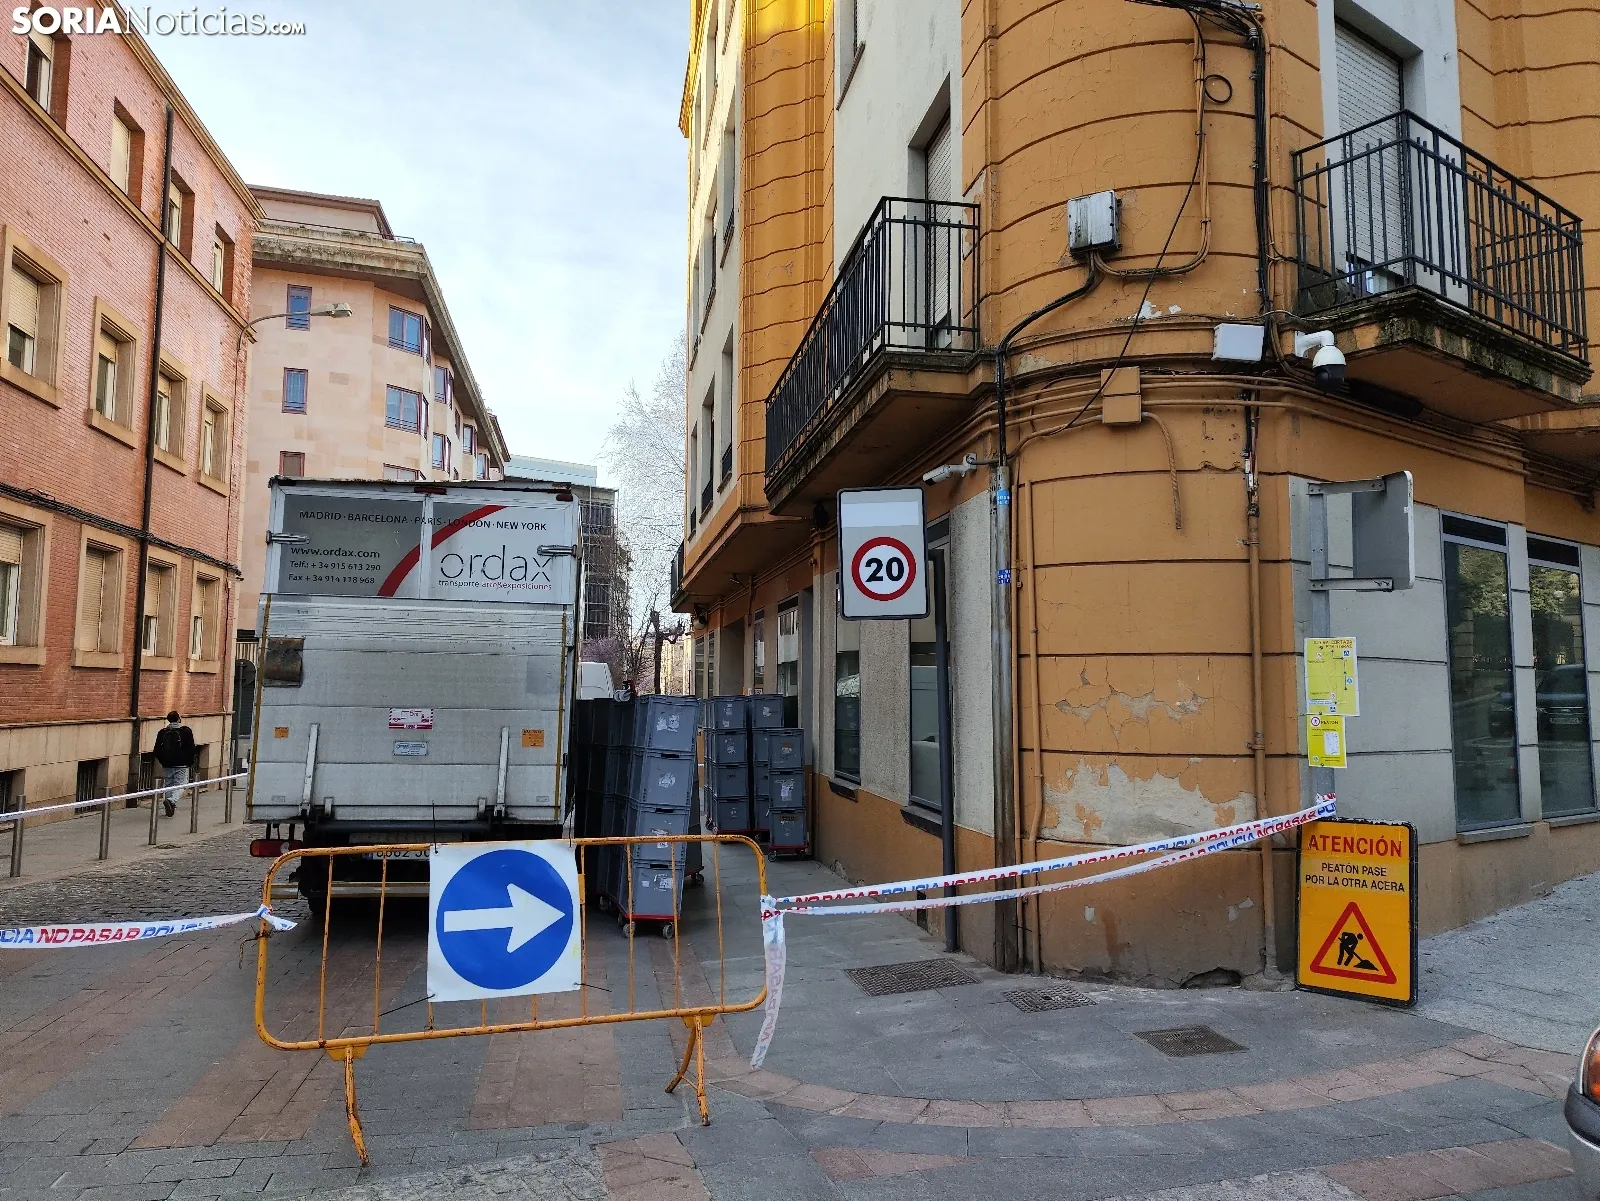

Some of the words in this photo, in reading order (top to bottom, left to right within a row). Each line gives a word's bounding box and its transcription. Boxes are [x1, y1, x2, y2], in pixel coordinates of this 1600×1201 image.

[299, 511, 342, 520] MADRID
[348, 513, 408, 524] BARCELONA
[496, 521, 518, 530] NEW
[521, 522, 547, 531] YORK
[290, 547, 380, 558] www.ordax.com
[441, 545, 551, 583] ordax
[864, 556, 905, 583] 20
[1308, 834, 1403, 858] ATENCIÓN
[1321, 862, 1359, 875] PEATÓN
[1362, 865, 1387, 877] PASE
[1305, 874, 1325, 884] POR
[1327, 876, 1339, 886] LA
[1341, 877, 1368, 889] OTRA
[1370, 880, 1405, 892] ACERA
